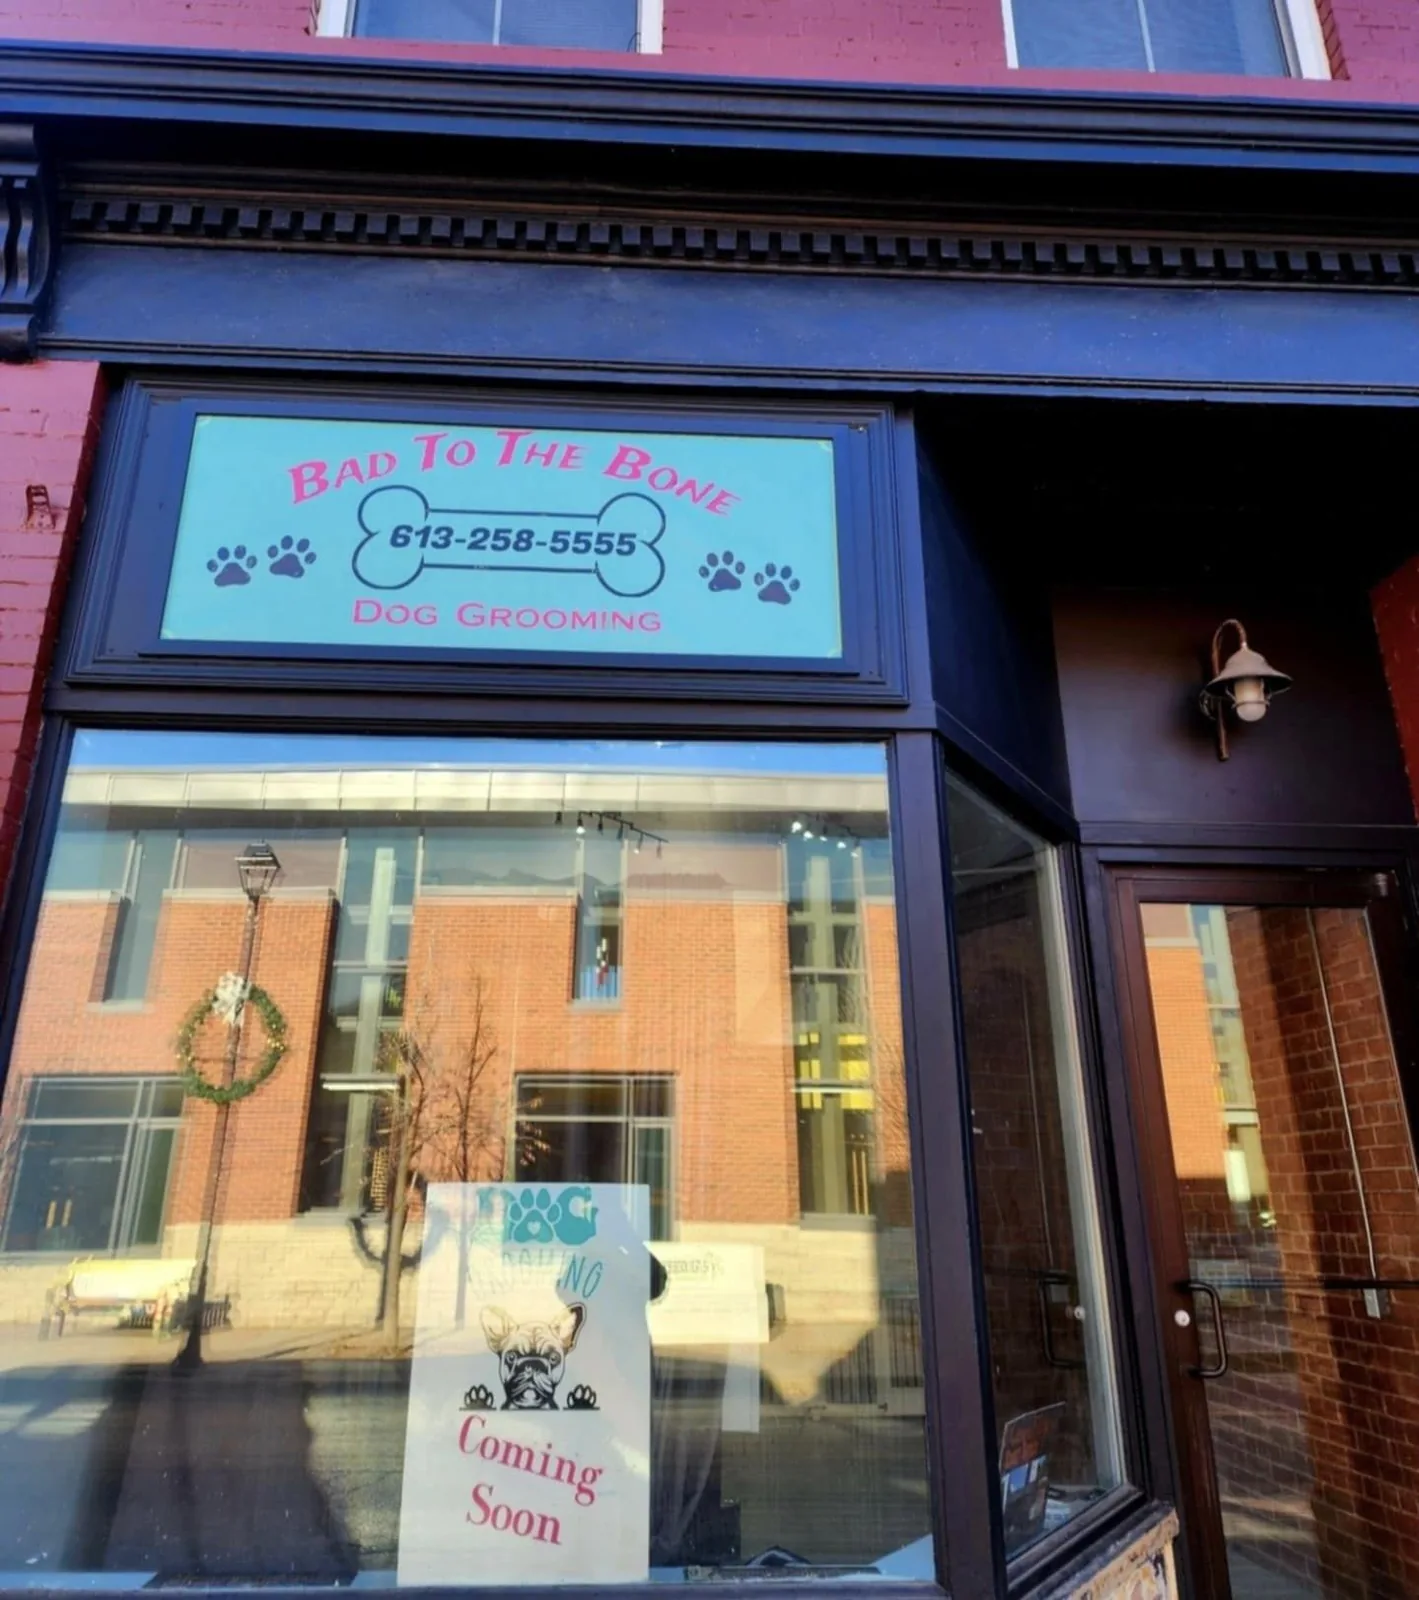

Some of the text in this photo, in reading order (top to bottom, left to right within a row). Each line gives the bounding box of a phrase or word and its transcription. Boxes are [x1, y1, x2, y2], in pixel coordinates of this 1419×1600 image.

[287, 429, 743, 516] BAD TO THE BONE
[389, 524, 638, 556] 613-258-5555
[353, 599, 663, 633] DOG GROOMING
[458, 1414, 604, 1507] Coming
[465, 1482, 562, 1546] Soon
